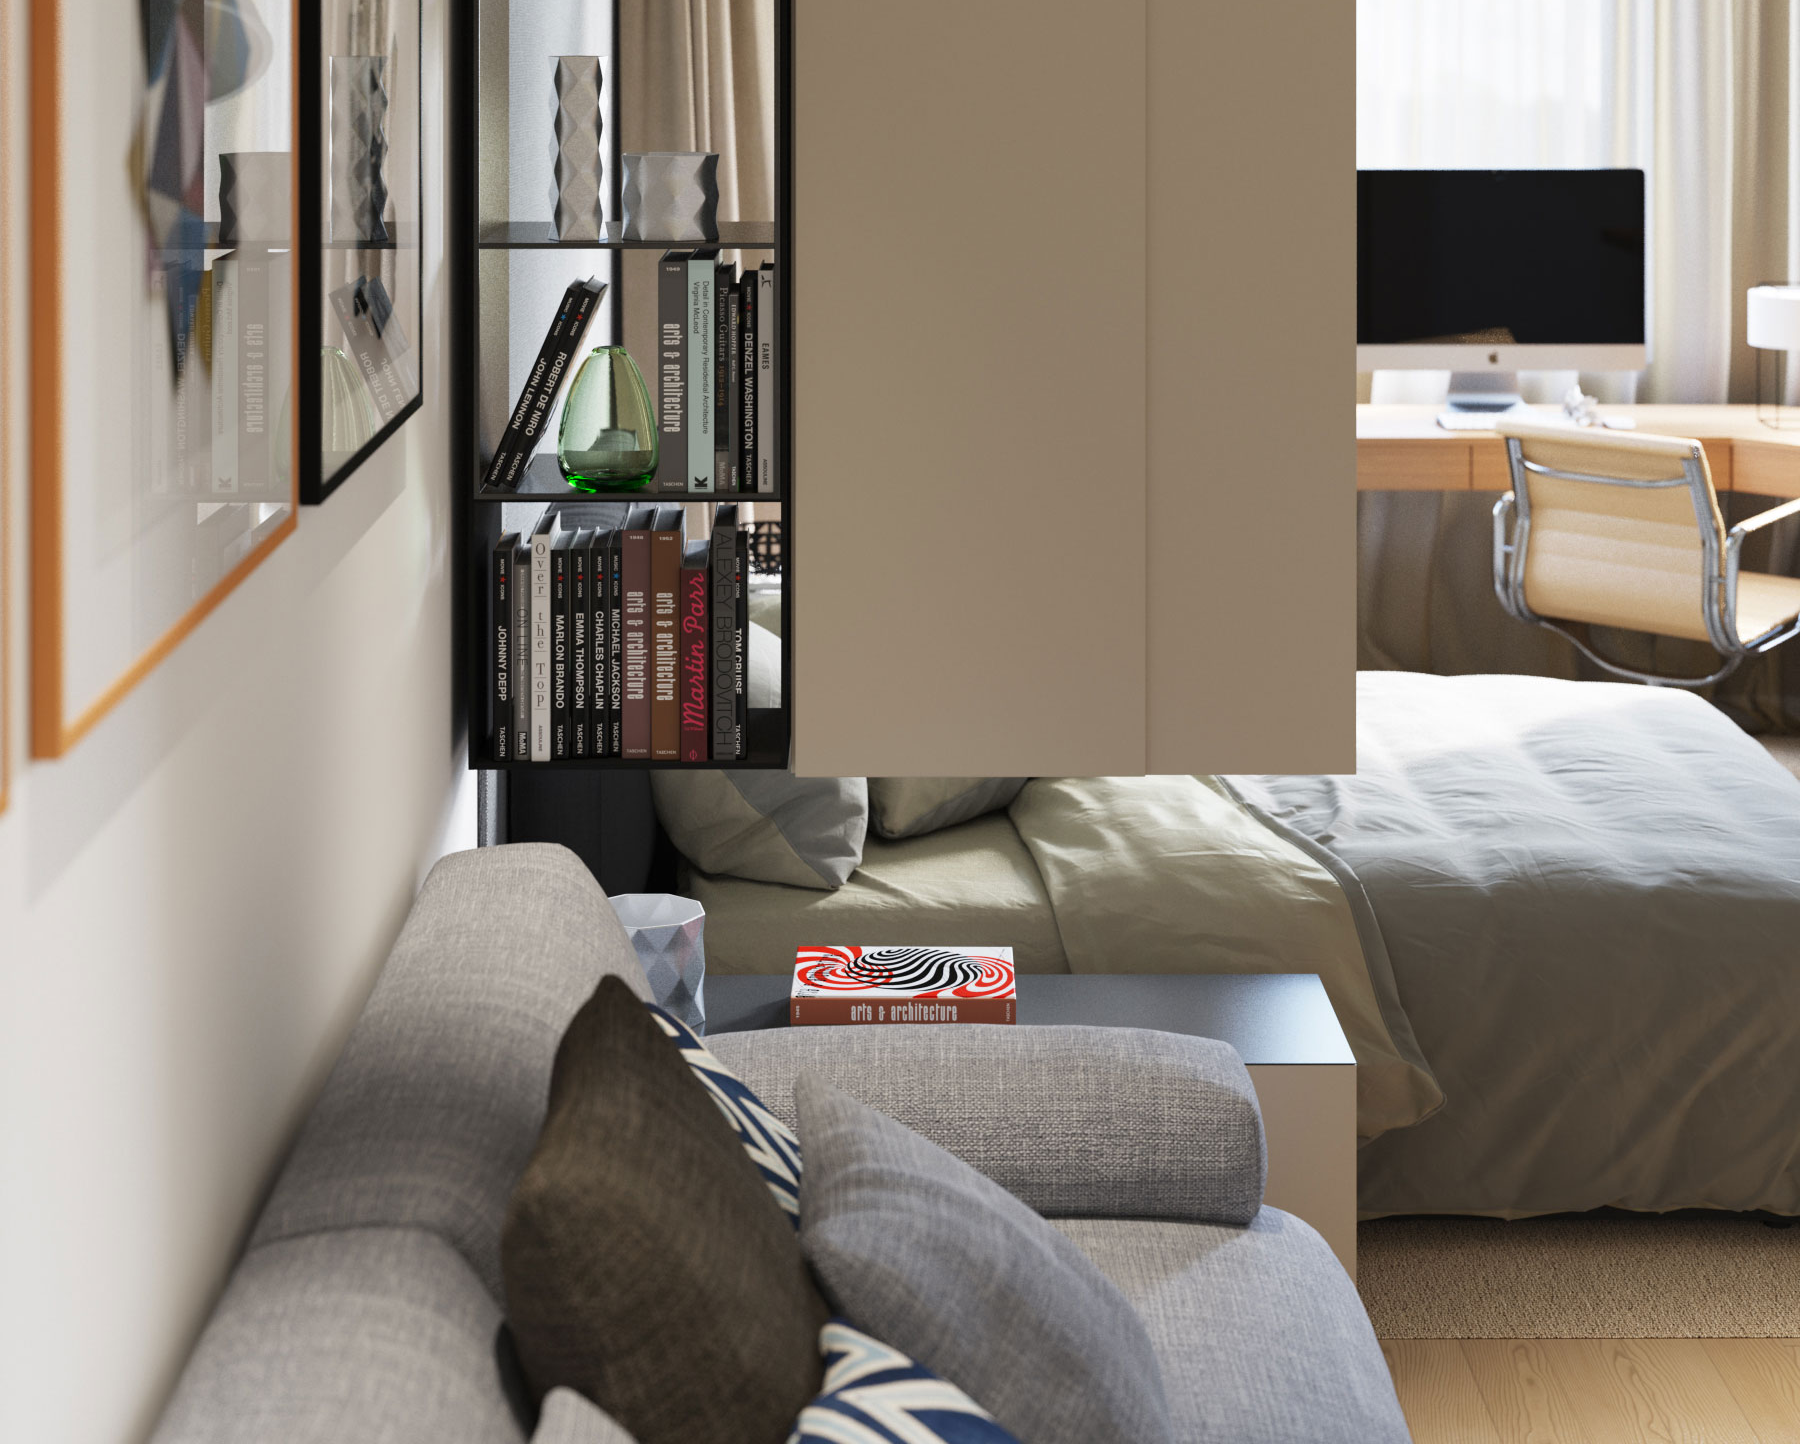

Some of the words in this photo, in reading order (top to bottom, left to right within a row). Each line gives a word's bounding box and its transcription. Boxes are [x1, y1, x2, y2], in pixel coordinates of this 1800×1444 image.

[692, 282, 700, 306] Virginia
[718, 287, 727, 322] Picasso
[664, 324, 680, 345] arts
[700, 309, 709, 355] Contemporary
[718, 325, 728, 361] Guitars
[528, 358, 546, 388] JOHN
[546, 352, 568, 395] ROBERT
[745, 333, 753, 374] DENZEL
[512, 389, 529, 430] LENNON
[538, 394, 549, 410] DE
[664, 360, 683, 433] architecture
[744, 377, 753, 449] WASHINGTON
[525, 409, 541, 436] NIRO
[490, 452, 506, 480] TASCHEN
[507, 453, 522, 480] TASCHEN
[535, 543, 546, 595] Over
[716, 533, 732, 609] ALEXEY
[517, 609, 528, 627] ON
[627, 592, 646, 613] arts
[656, 593, 675, 614] arts
[684, 573, 704, 633] Parr
[498, 625, 506, 670] JOHNNY
[535, 612, 546, 649] the
[556, 615, 564, 661] MARLON
[576, 613, 584, 646] EMMA
[595, 611, 604, 660] CHARLES
[612, 609, 620, 656] MICHAEL
[517, 636, 528, 666] LINE
[627, 632, 648, 699] architecture
[656, 633, 677, 700] architecture
[498, 673, 506, 700] DEPP
[556, 664, 564, 708] BRANDO
[576, 648, 584, 708] THOMPSON
[595, 663, 604, 709] CHAPLIN
[611, 659, 620, 709] JACKSON
[683, 640, 704, 727] Martin
[716, 617, 732, 744] BRODOVITCH
[851, 1005, 872, 1021] arts
[879, 1006, 885, 1021] &
[891, 1002, 957, 1021] architecture
